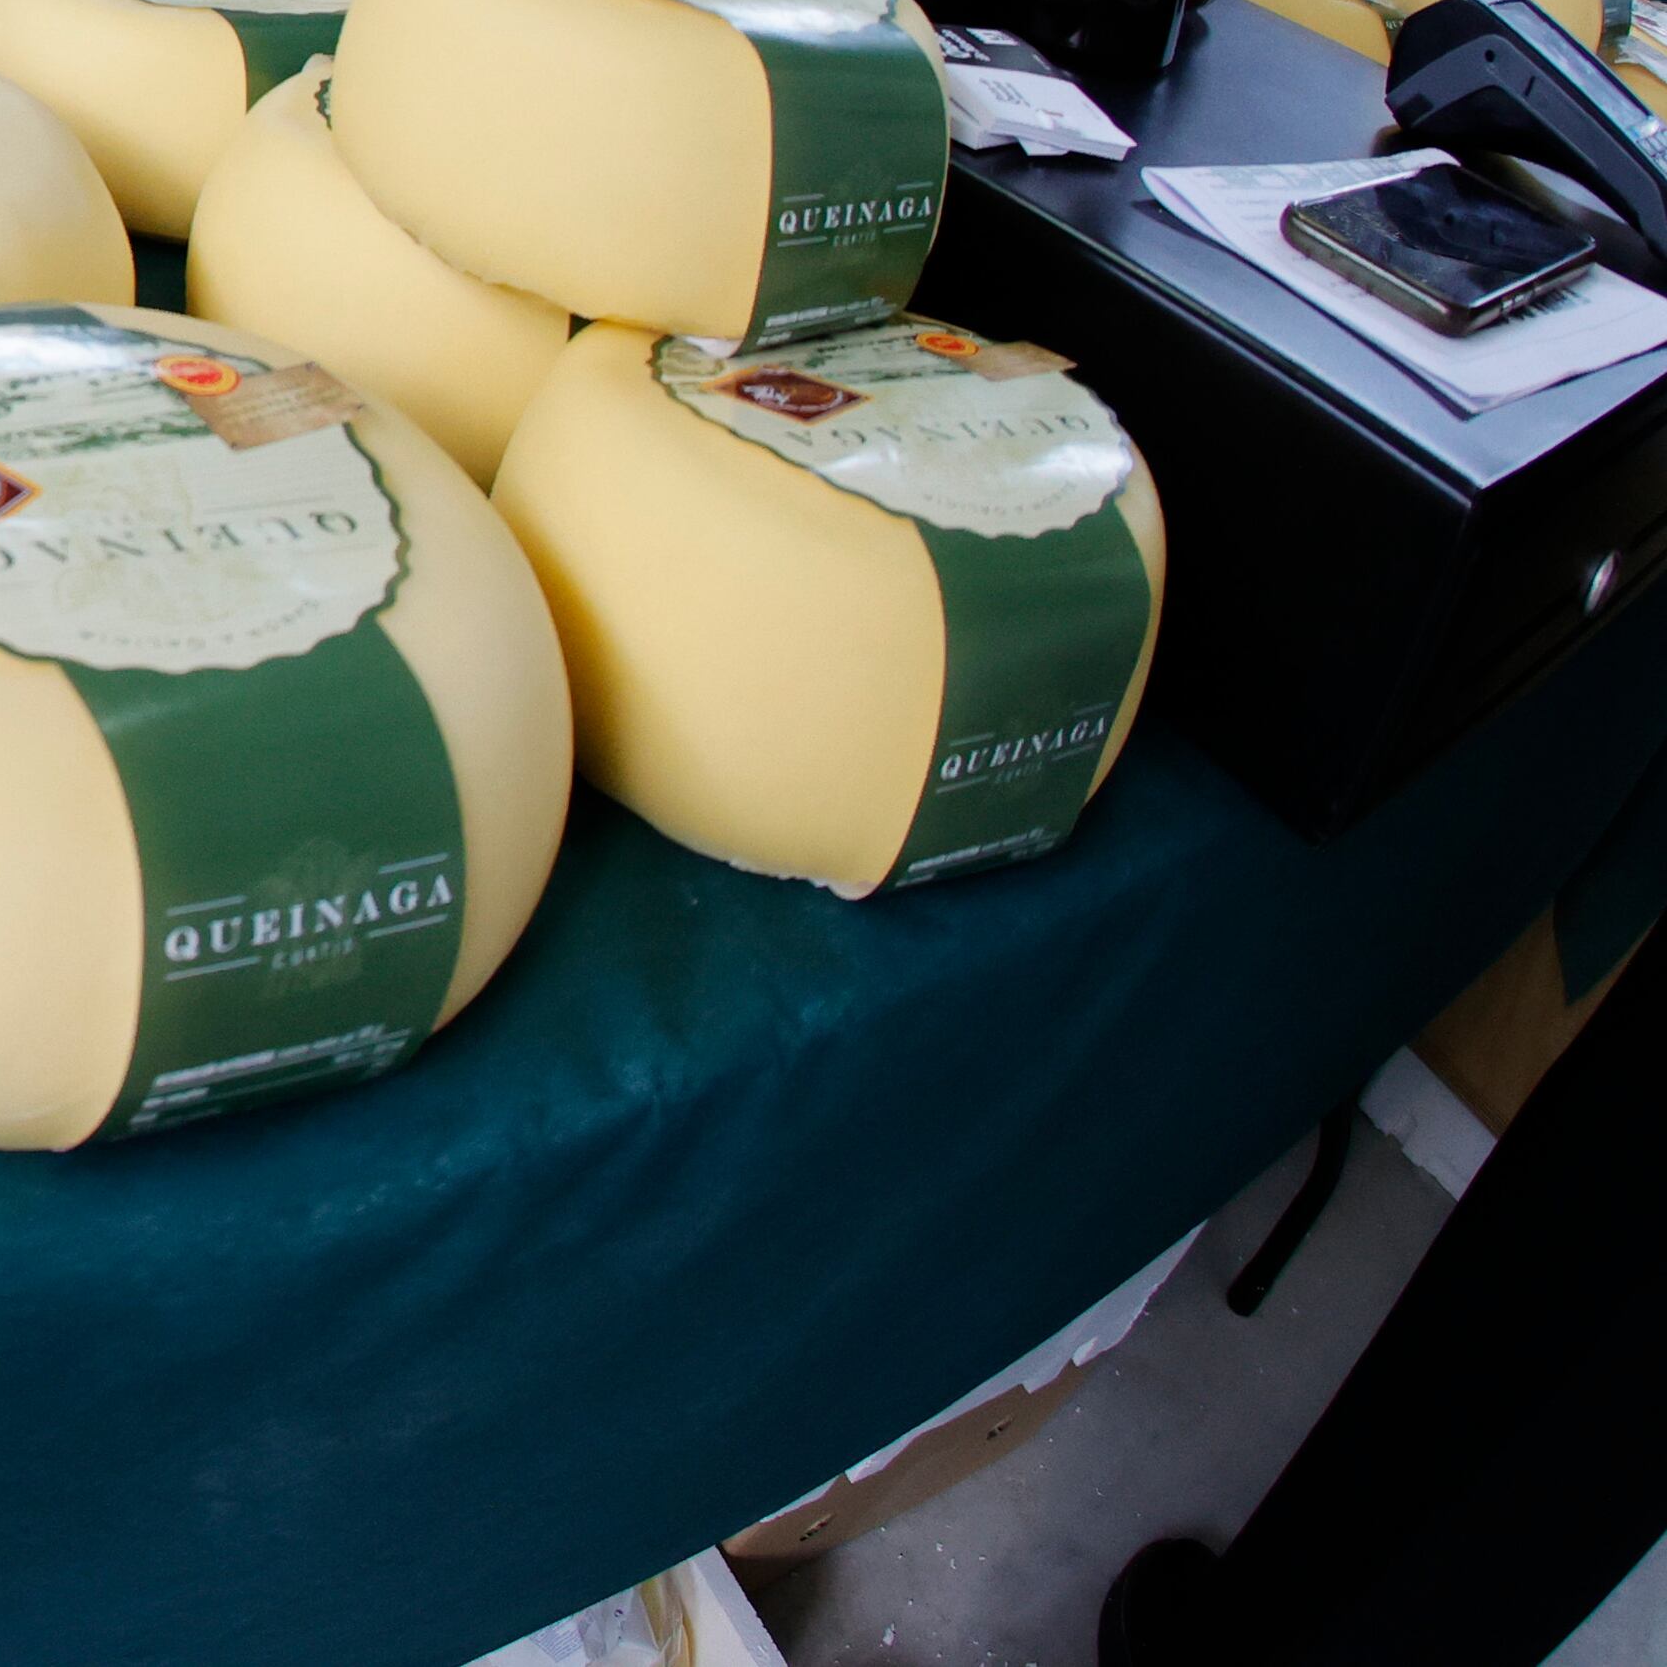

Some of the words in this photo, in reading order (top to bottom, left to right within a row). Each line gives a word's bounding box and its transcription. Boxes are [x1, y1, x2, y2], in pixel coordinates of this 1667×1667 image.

[778, 195, 933, 235] QUEINAGA
[940, 717, 1106, 781] QUEINAGA
[164, 873, 454, 962] QUEINAGA
